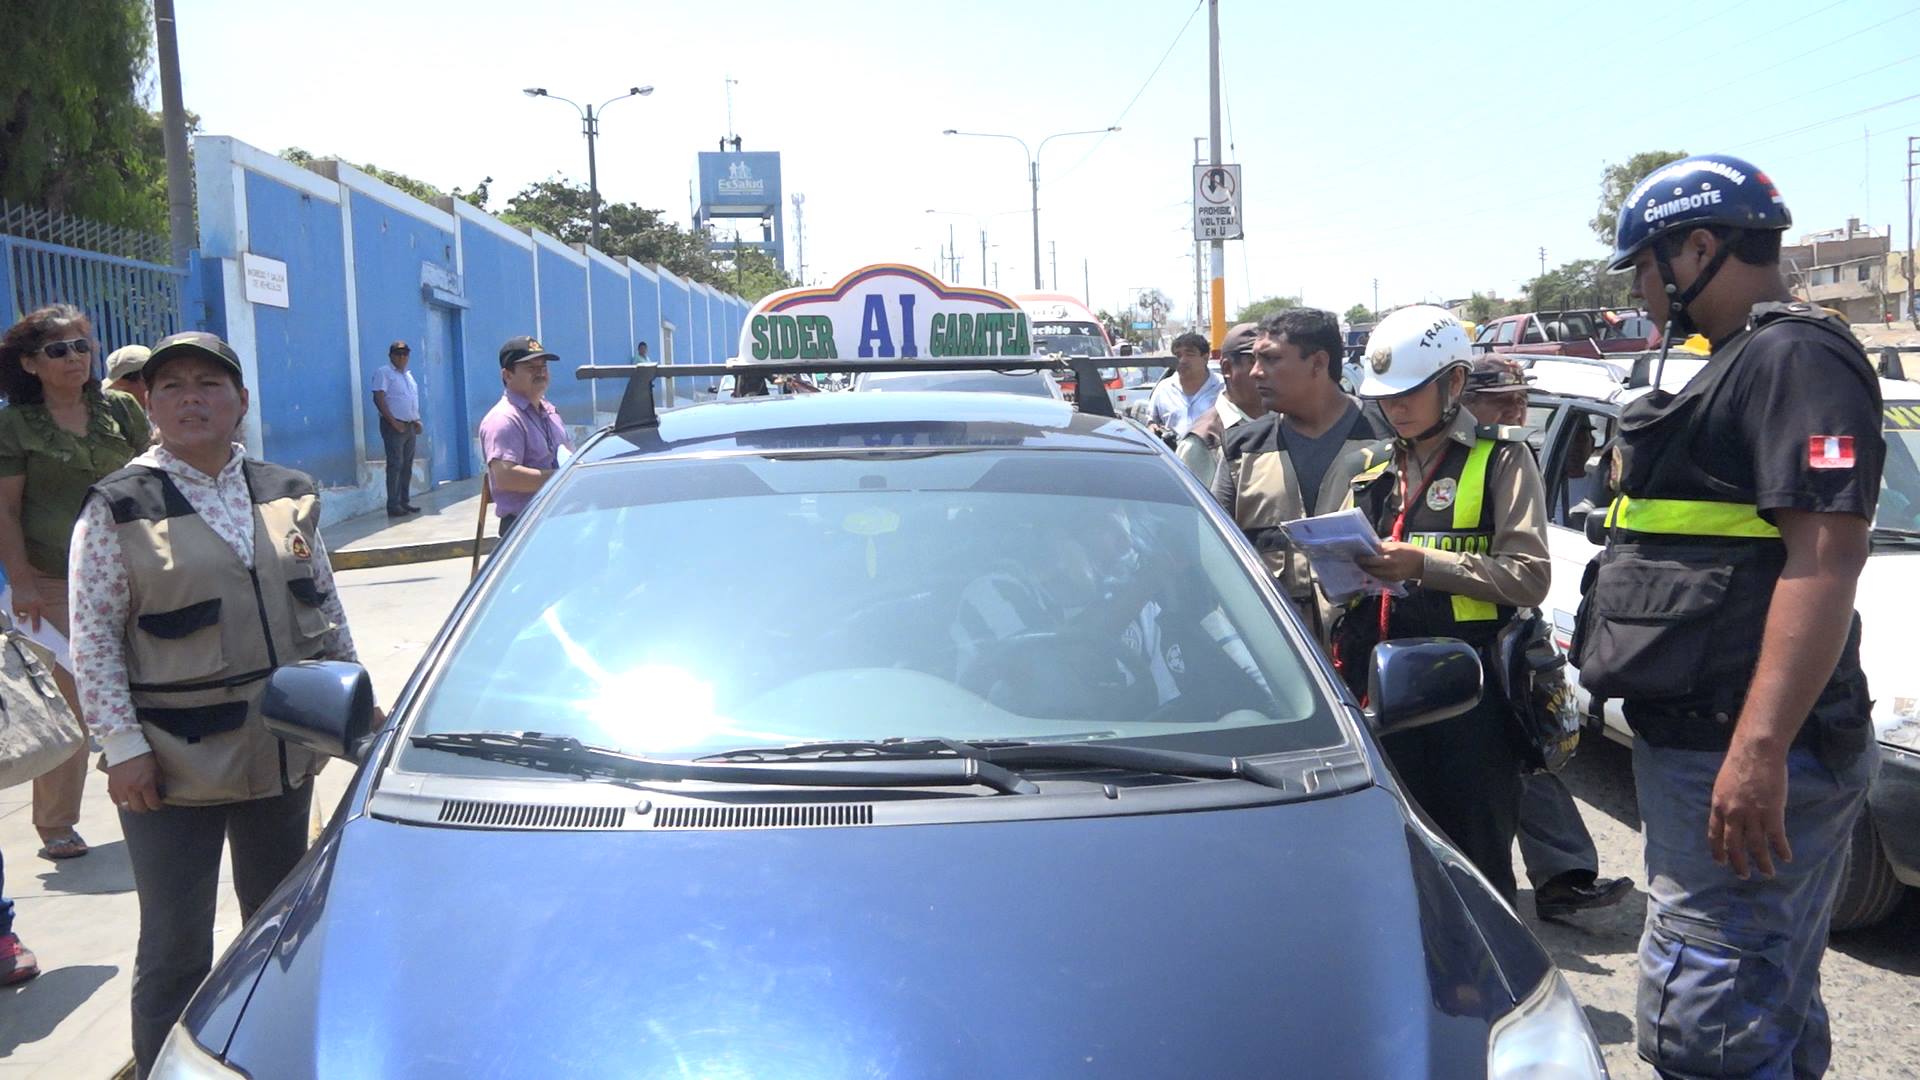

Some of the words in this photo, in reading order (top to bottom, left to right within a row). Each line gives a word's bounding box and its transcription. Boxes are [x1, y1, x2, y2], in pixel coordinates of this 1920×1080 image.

[1643, 189, 1723, 223] CHIMBOTE
[1205, 227, 1217, 237] EN
[1219, 226, 1226, 236] U
[751, 314, 838, 360] SIDER
[929, 312, 1031, 357] GARATEA
